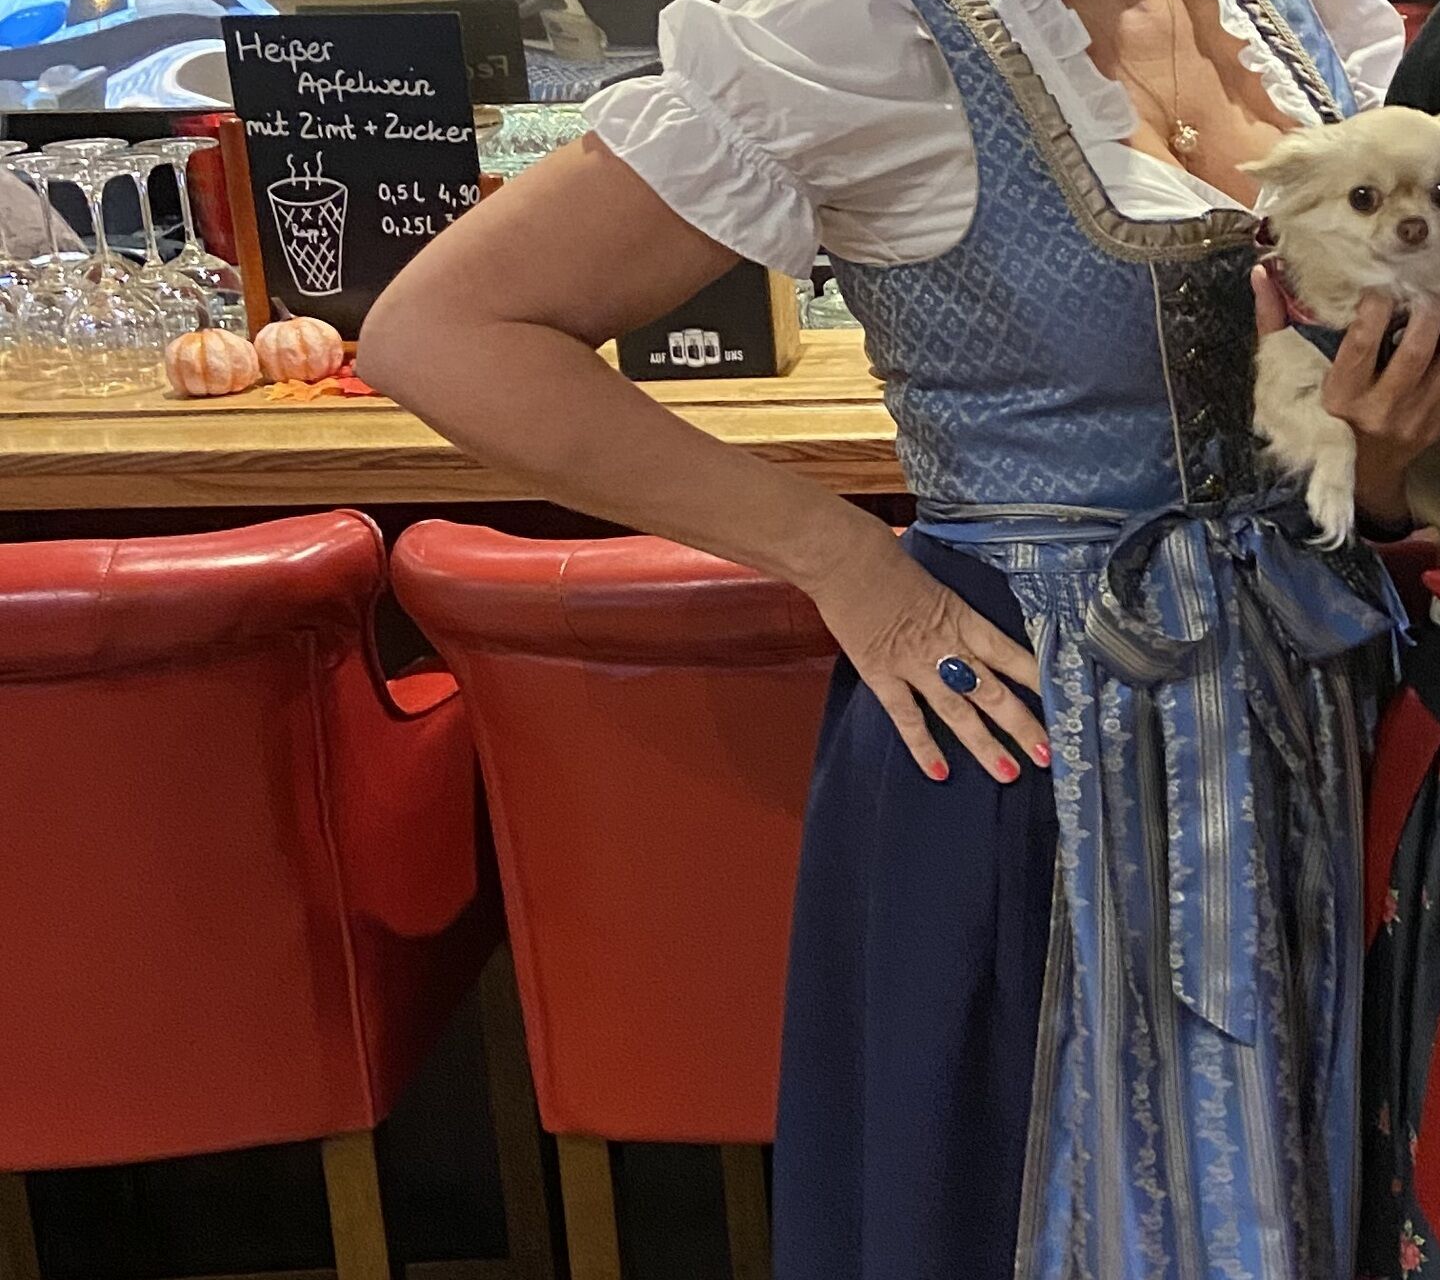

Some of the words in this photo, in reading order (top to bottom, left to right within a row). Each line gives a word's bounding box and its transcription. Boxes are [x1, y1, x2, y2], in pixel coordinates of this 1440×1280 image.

[235, 30, 334, 73] Heißer
[297, 67, 436, 105] Apfelwein
[245, 111, 290, 137] mit
[299, 111, 357, 141] Zimt
[384, 112, 473, 143] Zucker
